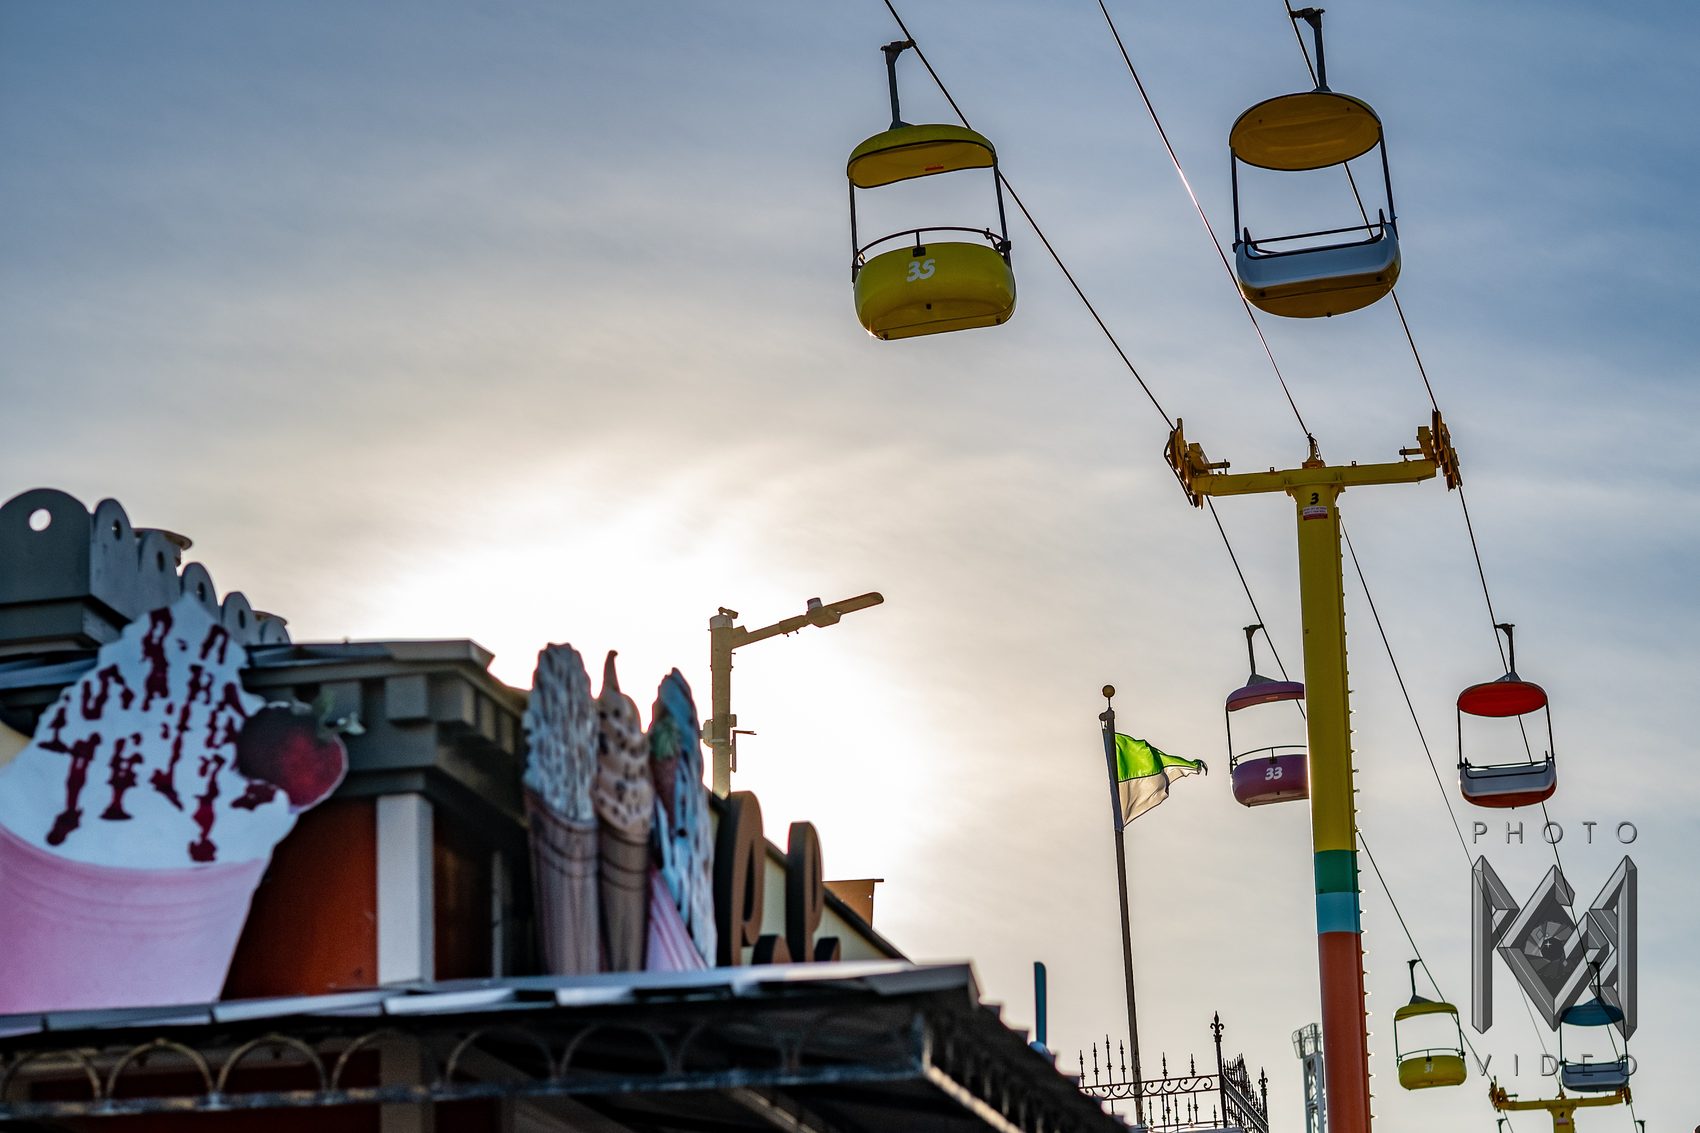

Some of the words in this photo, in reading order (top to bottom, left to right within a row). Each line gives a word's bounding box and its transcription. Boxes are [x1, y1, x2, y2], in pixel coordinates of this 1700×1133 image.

[907, 259, 936, 282] 35
[1310, 492, 1319, 505] 3
[1264, 766, 1283, 781] 33
